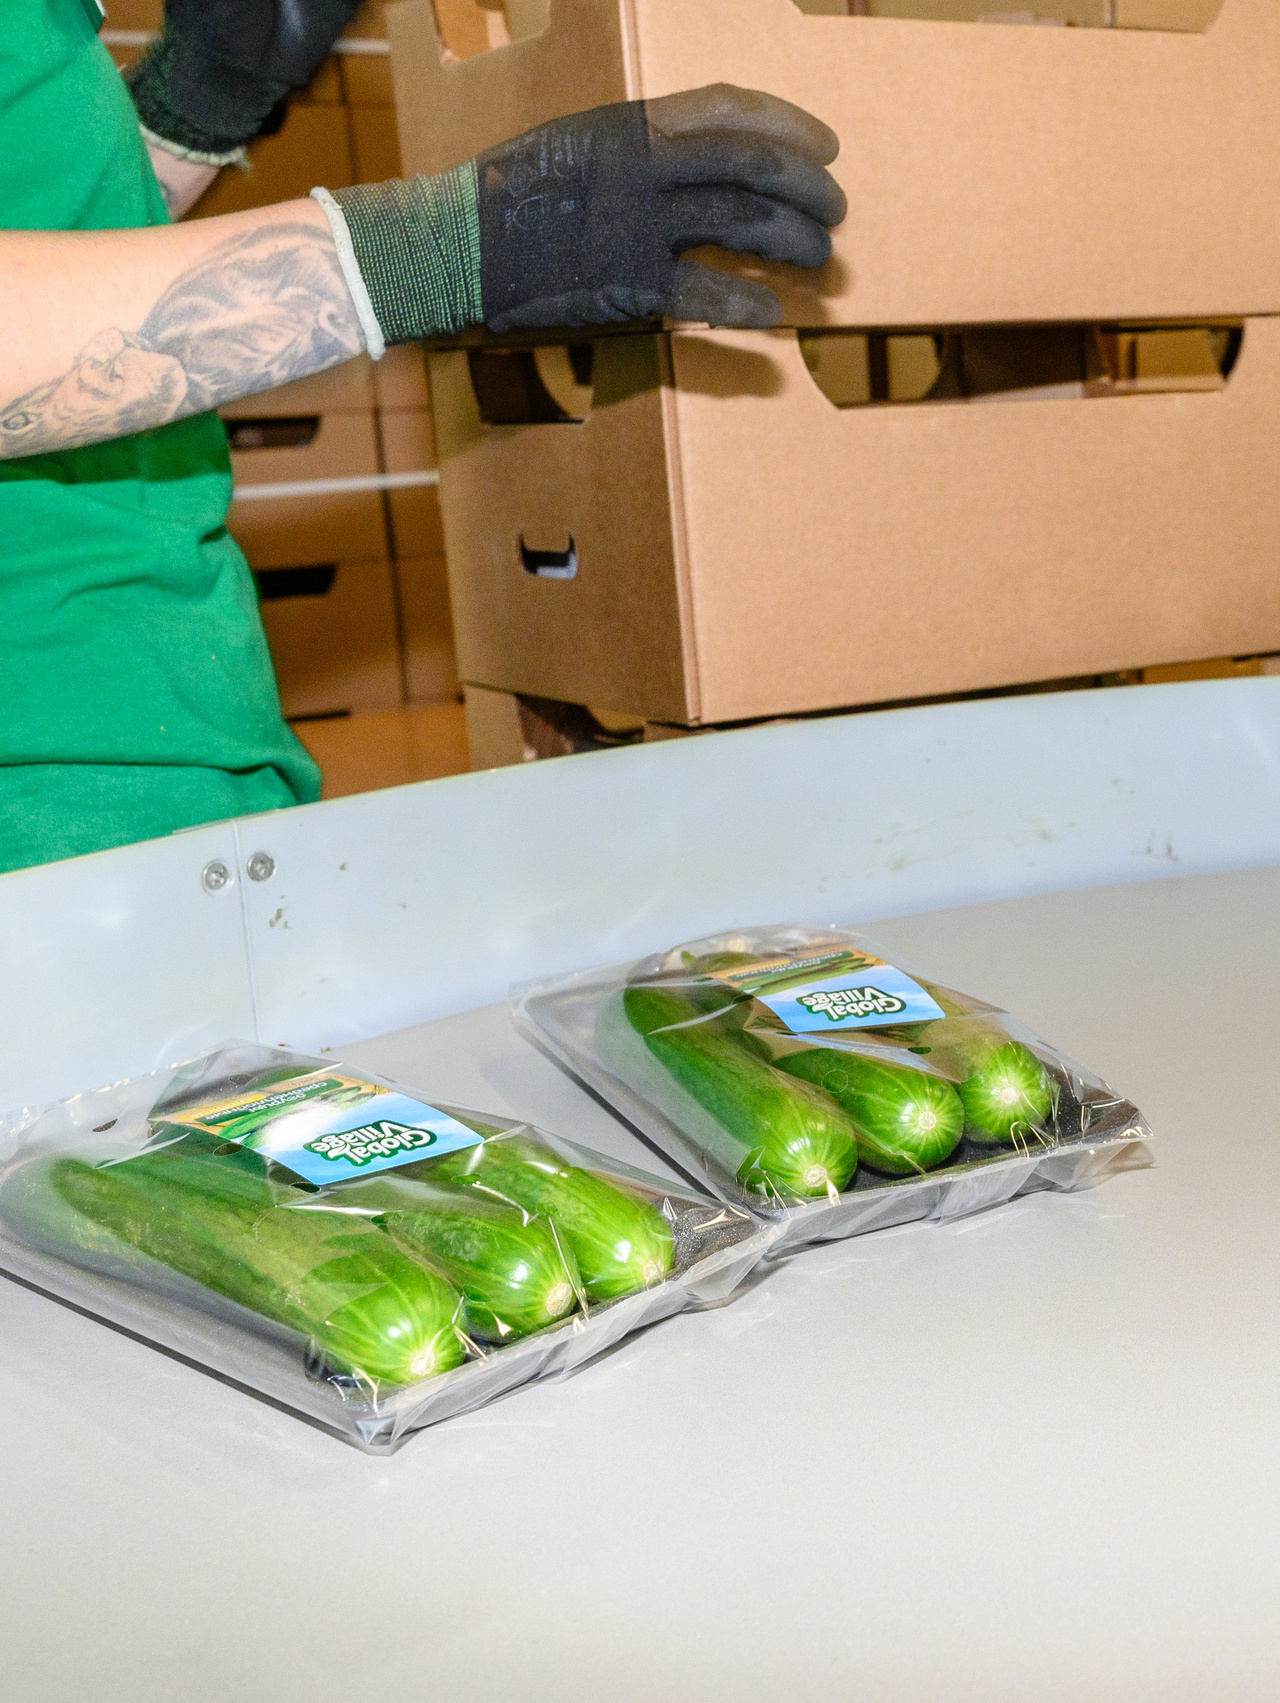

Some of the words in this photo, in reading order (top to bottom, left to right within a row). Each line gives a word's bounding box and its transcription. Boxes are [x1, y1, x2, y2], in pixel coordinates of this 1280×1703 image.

[802, 987, 888, 1006] Village
[812, 997, 902, 1020] Global
[311, 1121, 412, 1152] Village
[327, 1130, 432, 1164] Global
